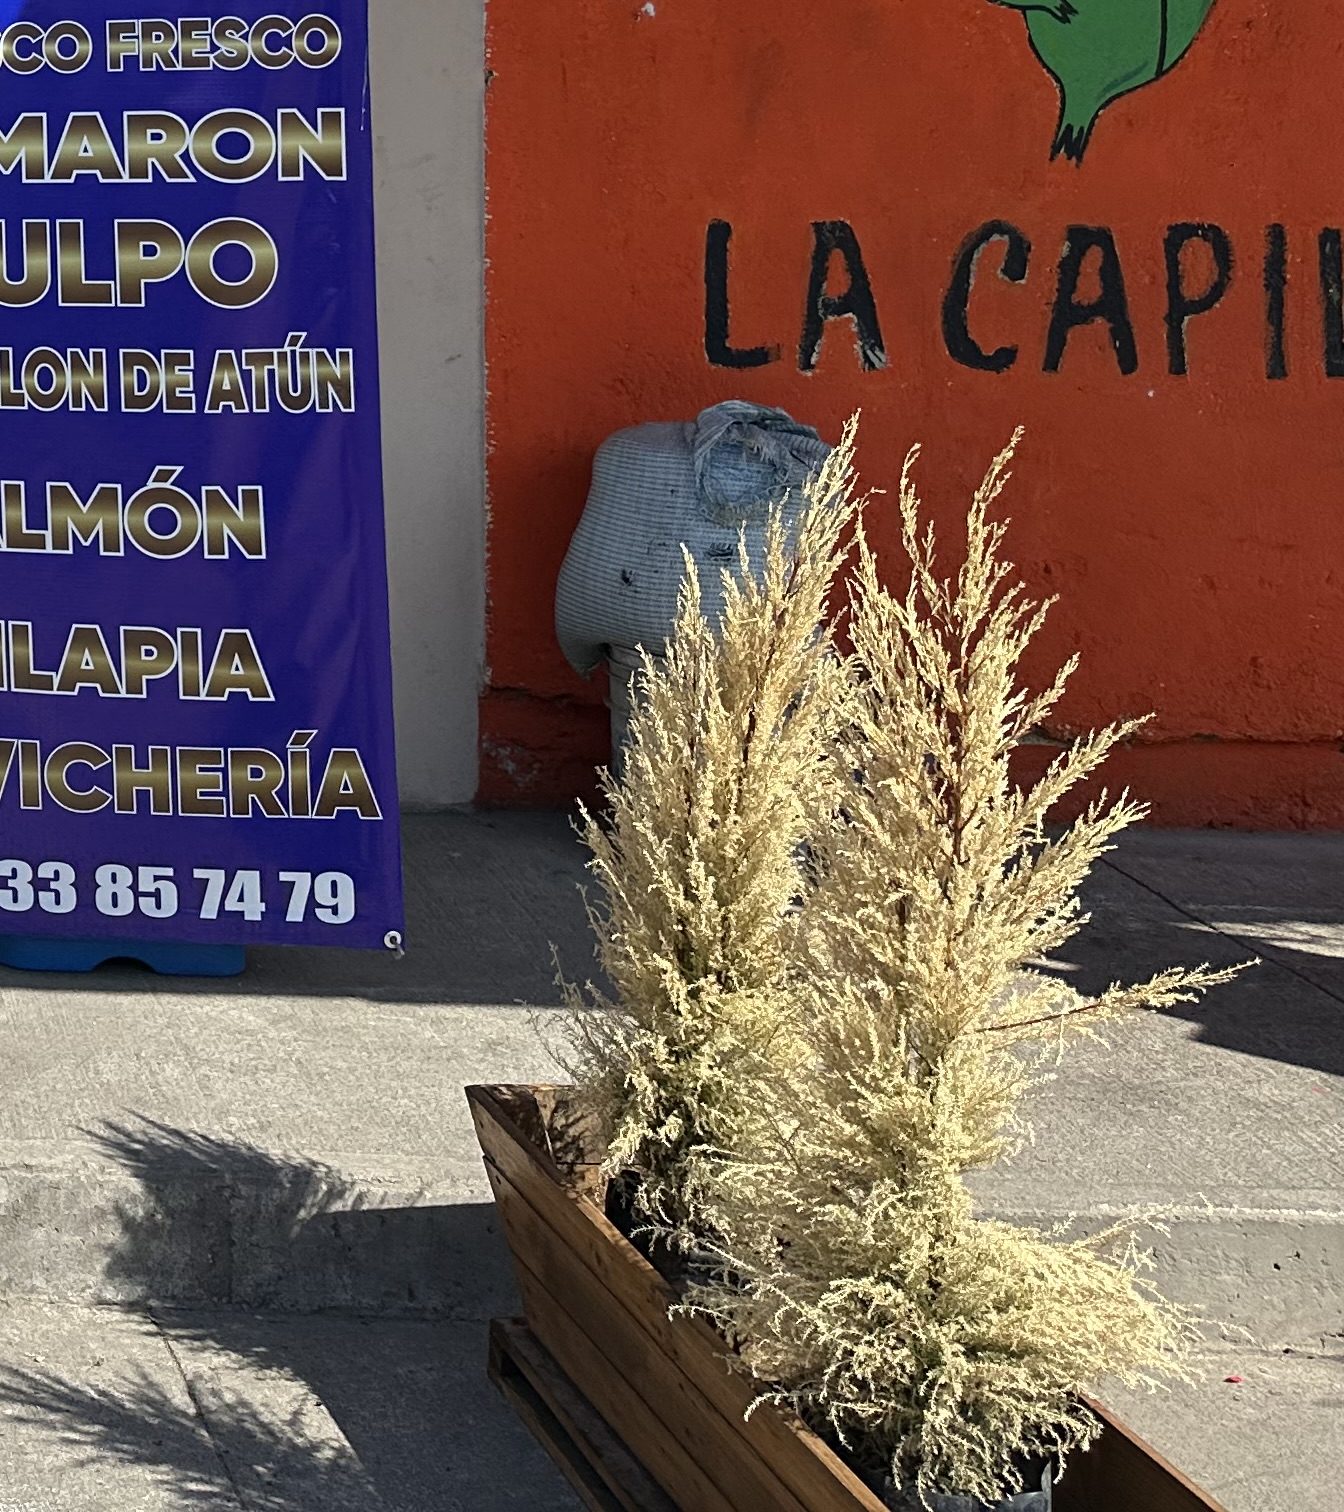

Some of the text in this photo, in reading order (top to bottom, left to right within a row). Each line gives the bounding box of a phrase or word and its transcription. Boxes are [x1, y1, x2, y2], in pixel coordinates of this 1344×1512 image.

[106, 13, 342, 73] FRESCO
[705, 219, 890, 375] LA
[119, 348, 197, 413] DE
[204, 332, 356, 414] ATÚN
[94, 864, 178, 918] 85
[193, 868, 265, 921] 74
[278, 871, 356, 924] 79
